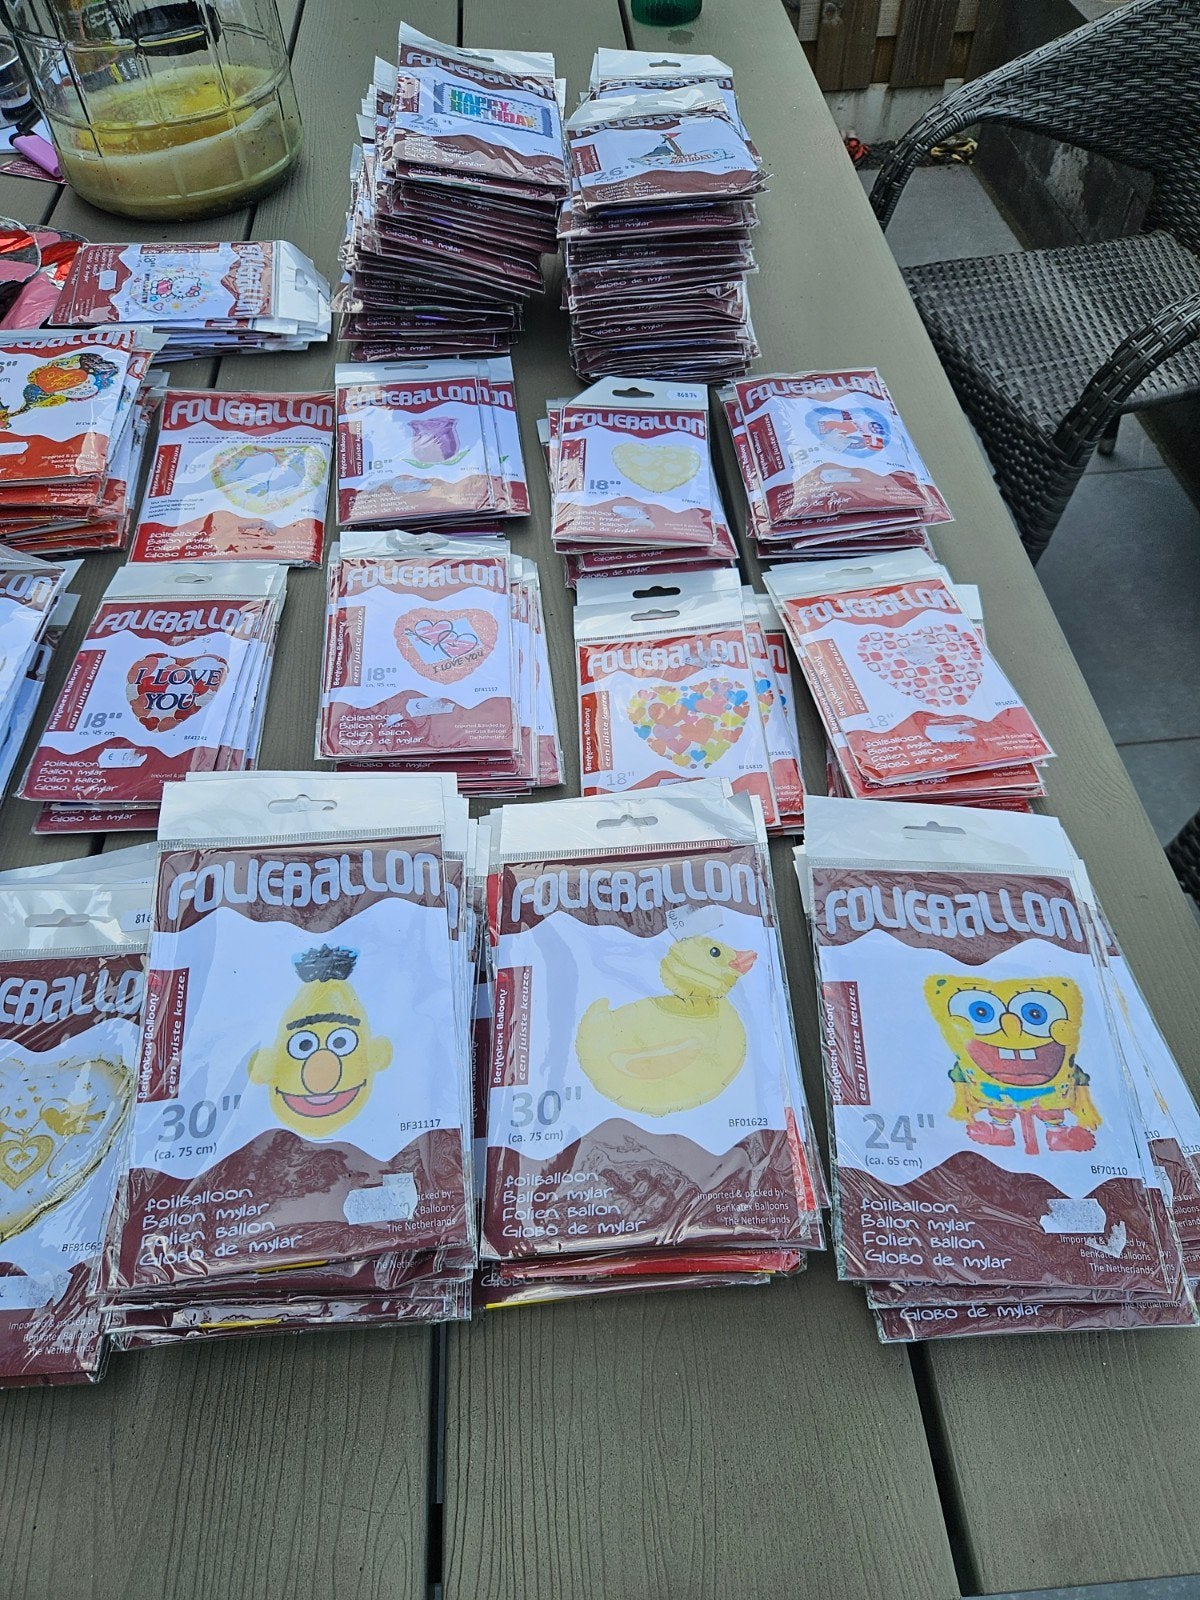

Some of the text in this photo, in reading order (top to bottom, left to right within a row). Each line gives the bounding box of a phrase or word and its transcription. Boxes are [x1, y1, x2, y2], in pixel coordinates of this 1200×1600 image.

[441, 656, 464, 672] LOVE
[135, 668, 222, 687] I LOVE
[144, 692, 197, 711] YOU
[166, 970, 187, 1095] een juiste keuze.
[518, 1012, 529, 1052] juiste
[848, 984, 868, 1101] een juiste keuze.
[509, 1086, 582, 1128] 30"
[157, 1094, 242, 1143] 30"
[400, 1119, 441, 1132] BF31117
[728, 1118, 769, 1127] BF01623
[508, 1129, 564, 1145] (ca. 75 cm)
[862, 1113, 935, 1151] 24"
[154, 1142, 217, 1162] (ca. 75 cm)
[865, 1154, 924, 1169] (ca. 65 cm)
[417, 1190, 440, 1201] acked
[503, 1186, 614, 1204] Ballon mylar
[745, 1188, 773, 1200] packed
[420, 1203, 456, 1215] Balloons
[502, 1207, 560, 1222] Folien
[754, 1201, 789, 1211] Balloons
[142, 1202, 270, 1231] Ballon mylar
[723, 1213, 791, 1225] The Netherlands
[861, 1214, 976, 1234] Ballon mylar
[387, 1218, 457, 1233] The Netherlands
[567, 1221, 589, 1235] de
[597, 1219, 648, 1236] mylar
[141, 1229, 205, 1249] Folien
[214, 1242, 239, 1257] de
[248, 1234, 303, 1254] mylar
[862, 1231, 922, 1246] Folien
[932, 1254, 955, 1267] de
[962, 1256, 1012, 1271] mylar
[1089, 1262, 1155, 1275] The Netherlands
[967, 1304, 989, 1318] de
[996, 1303, 1044, 1318] mylar
